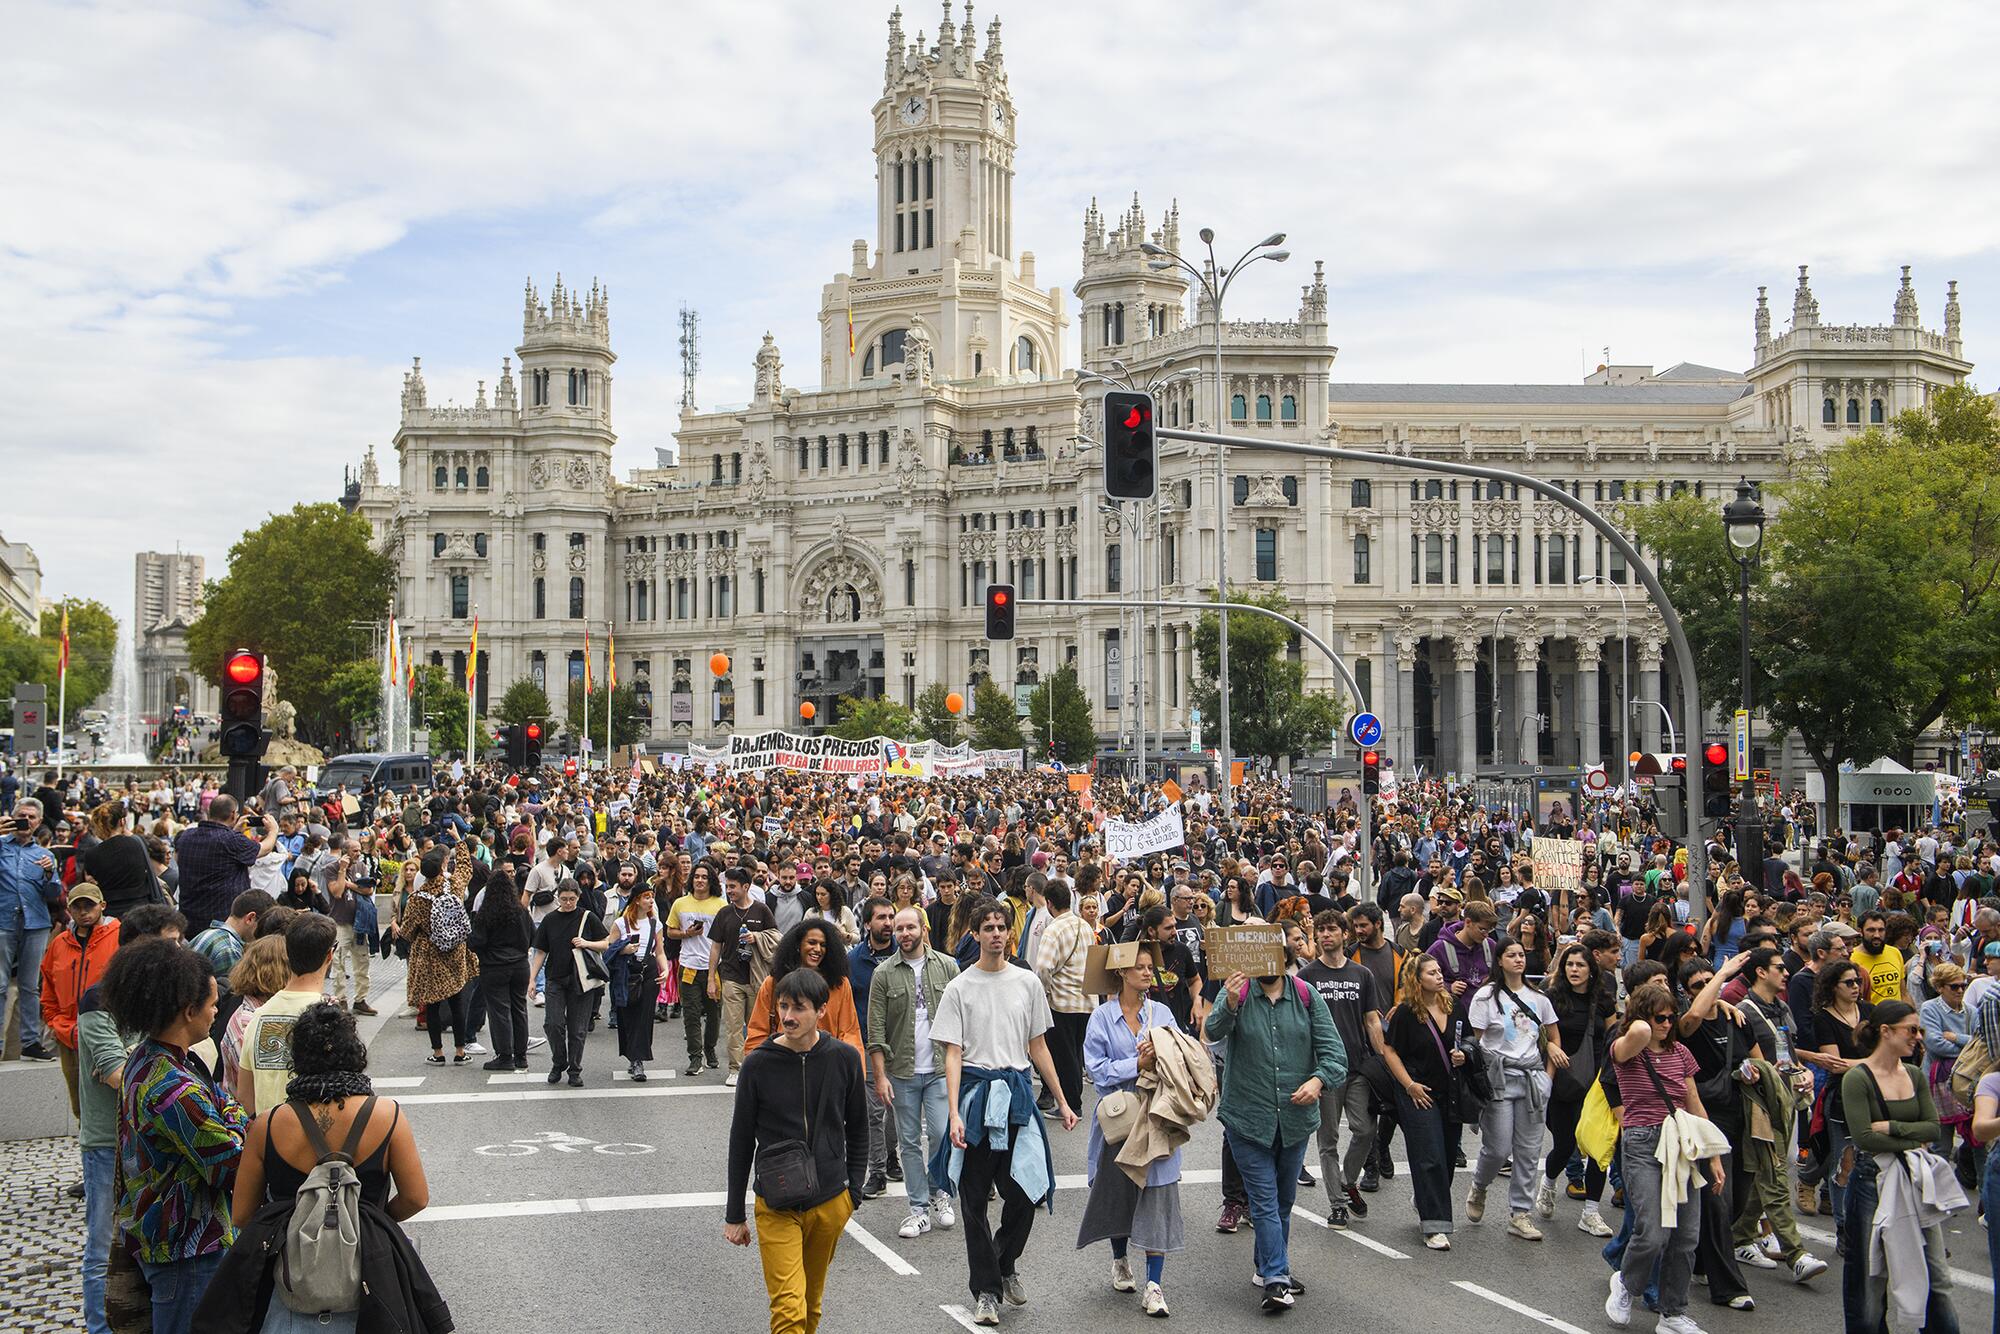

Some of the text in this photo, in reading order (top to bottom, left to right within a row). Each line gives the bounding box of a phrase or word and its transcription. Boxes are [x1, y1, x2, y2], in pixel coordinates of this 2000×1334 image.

[731, 731, 794, 755] BAJEMOS
[795, 738, 821, 755] LOS
[821, 736, 880, 757] PRECIOS
[732, 752, 880, 772] A POR LA HUELGA DE ALQUILERES
[1108, 835, 1132, 852] PISO
[1209, 930, 1283, 944] EL LIBERALISMO
[1219, 943, 1265, 953] ENMASCARA
[1211, 952, 1274, 964] EL FEUDALISMO
[1872, 972, 1899, 985] STOP
